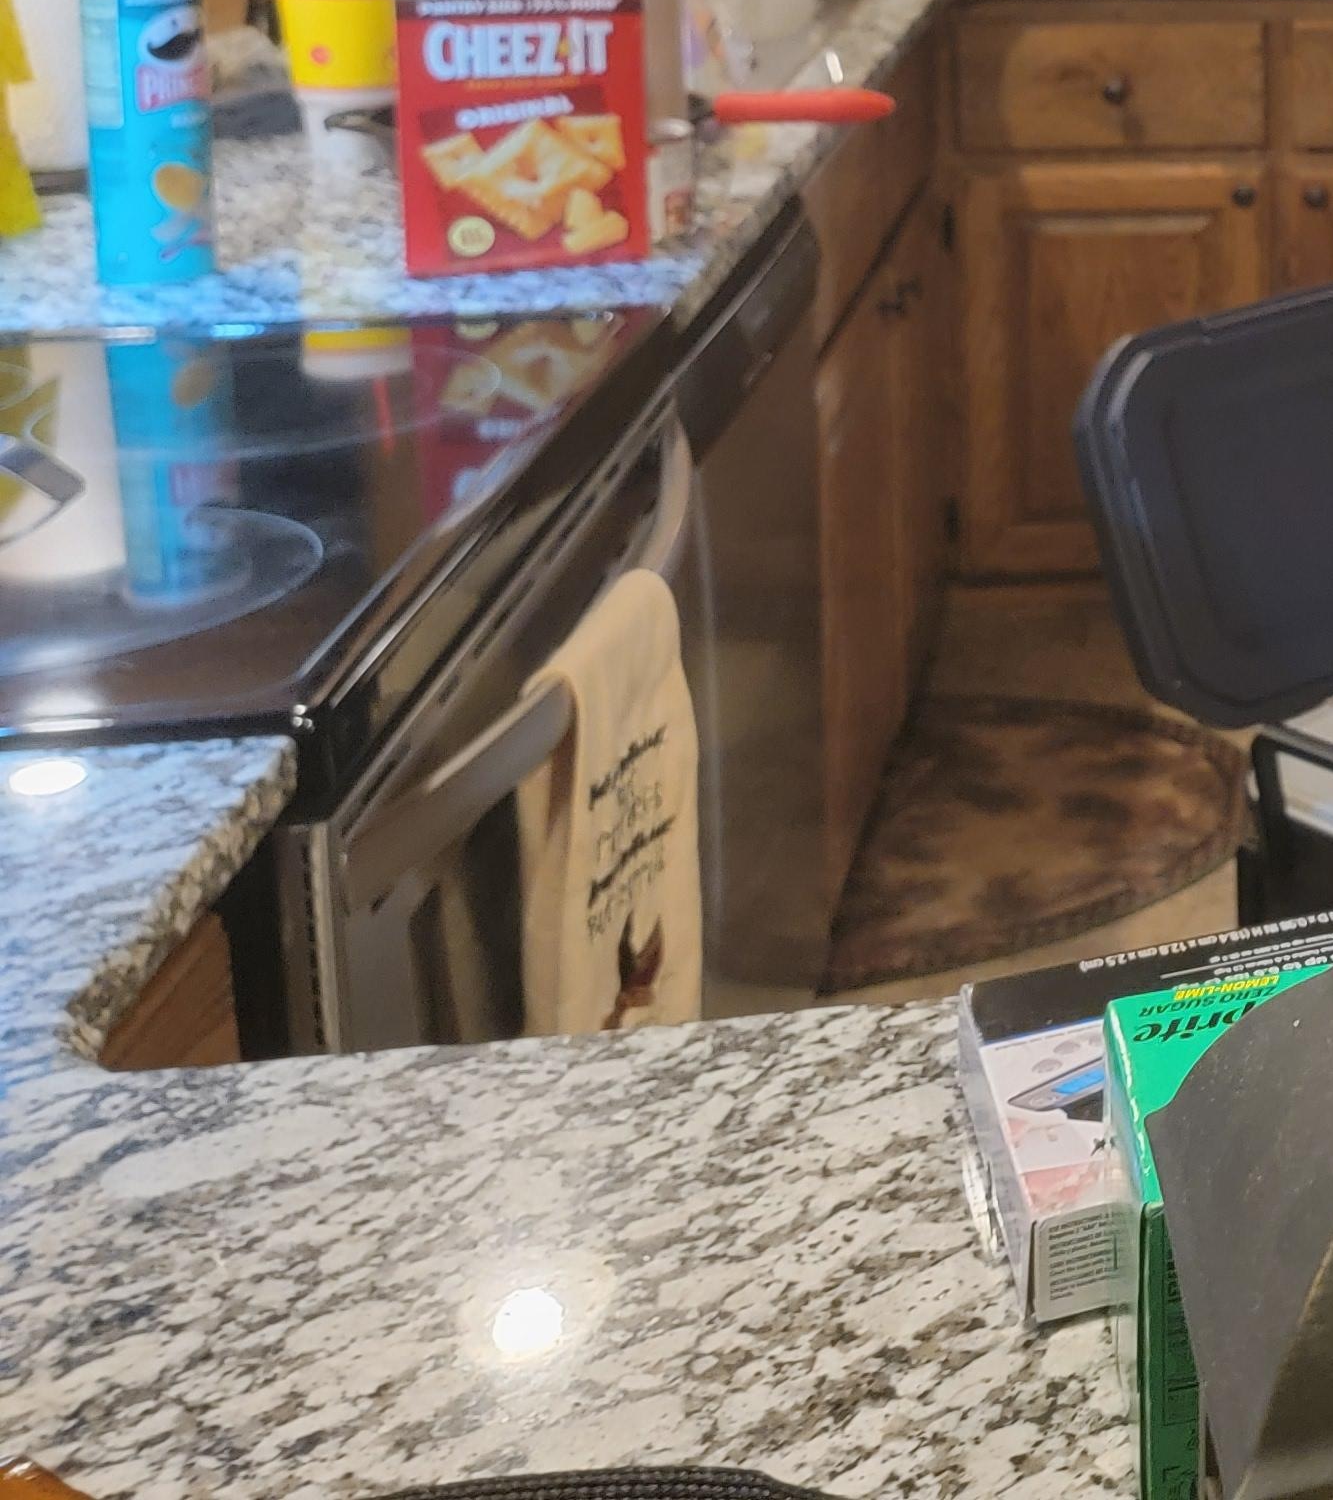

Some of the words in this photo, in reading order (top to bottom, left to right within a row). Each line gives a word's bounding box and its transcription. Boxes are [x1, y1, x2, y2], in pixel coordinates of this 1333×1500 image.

[1198, 934, 1218, 947] cm
[1136, 947, 1157, 959] cm
[1079, 957, 1105, 974] cm)
[1174, 974, 1280, 1000] LEMON-LIME
[1218, 986, 1277, 1005] ZERO
[1139, 994, 1214, 1018] SUGAR
[1133, 1001, 1255, 1043] prite
